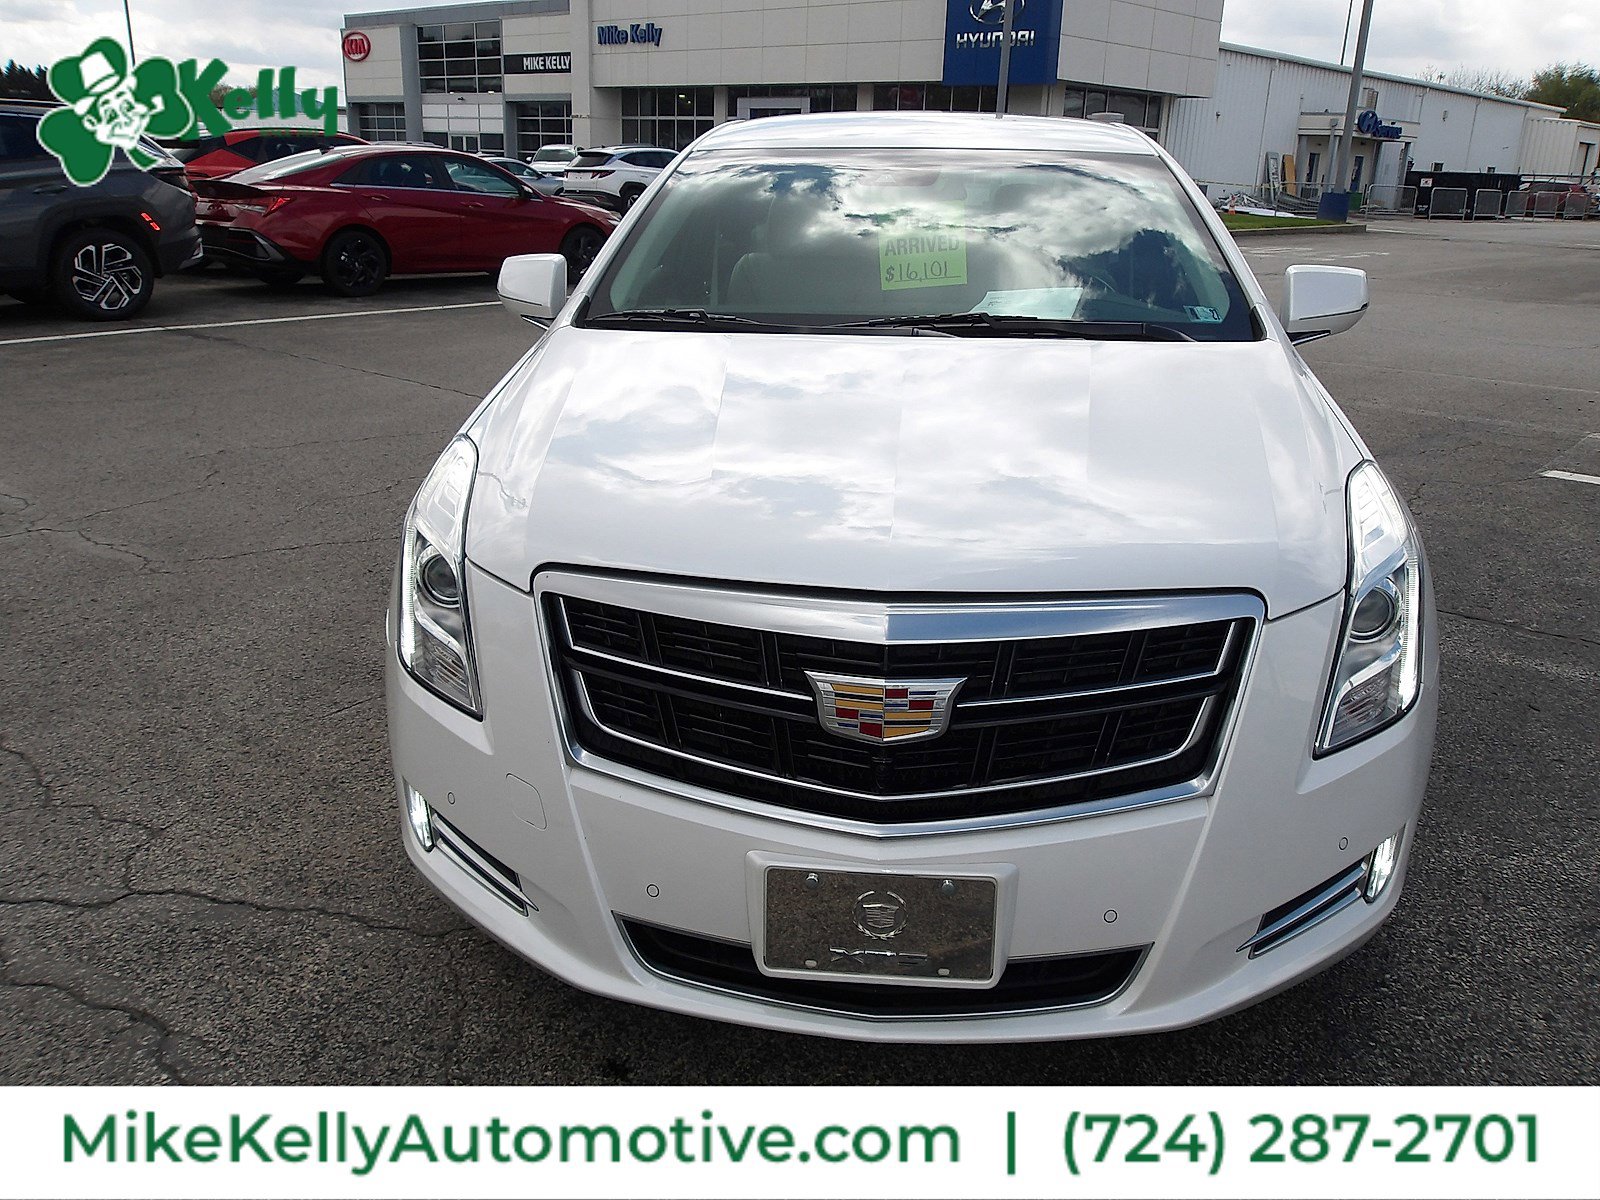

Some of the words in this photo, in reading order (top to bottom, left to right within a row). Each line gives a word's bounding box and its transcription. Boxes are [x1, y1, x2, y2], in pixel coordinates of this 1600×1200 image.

[597, 26, 628, 45] Mike
[630, 22, 663, 47] Kelly
[345, 38, 366, 54] KIA
[523, 56, 545, 71] MIKE
[545, 55, 571, 70] KELLY
[885, 234, 960, 256] ARRIVED
[885, 261, 948, 282] $16,101
